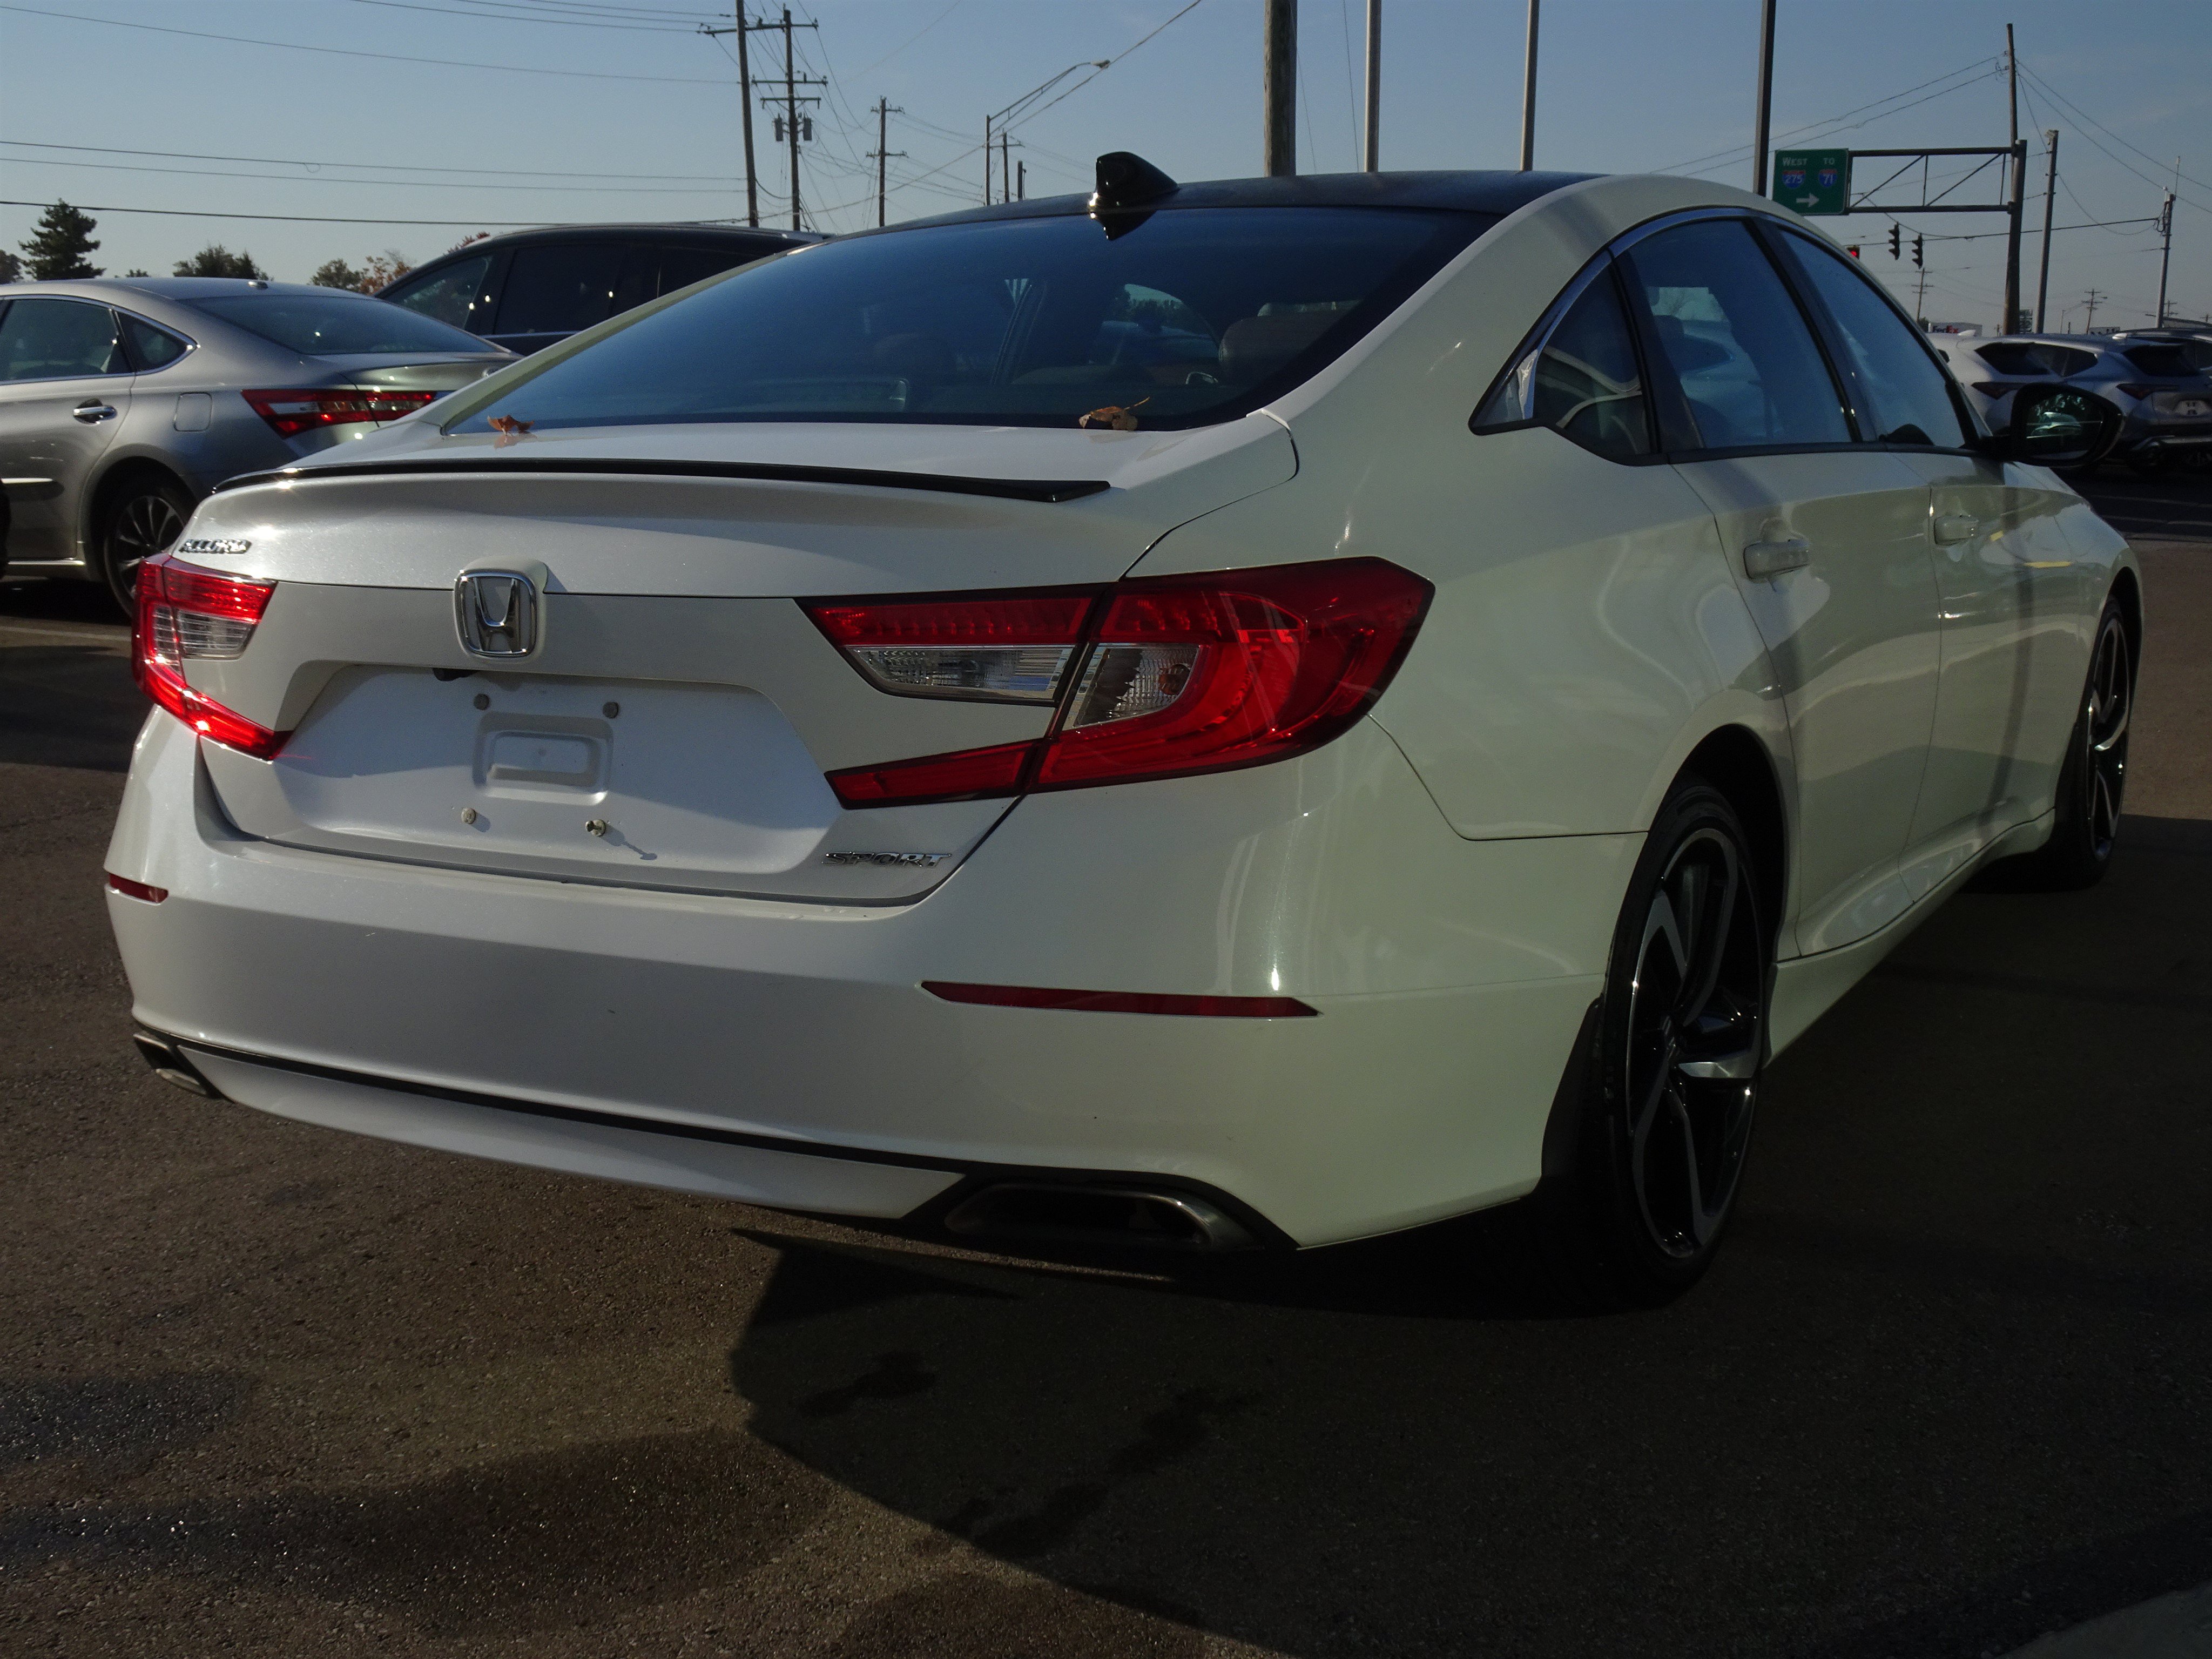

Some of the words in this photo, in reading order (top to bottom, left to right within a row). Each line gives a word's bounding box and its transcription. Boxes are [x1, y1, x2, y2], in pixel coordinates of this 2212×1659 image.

[1783, 157, 1807, 166] WEST
[1823, 157, 1835, 165] TO
[1785, 174, 1802, 184] 275
[1823, 173, 1833, 184] 71
[821, 851, 953, 866] SPORT
